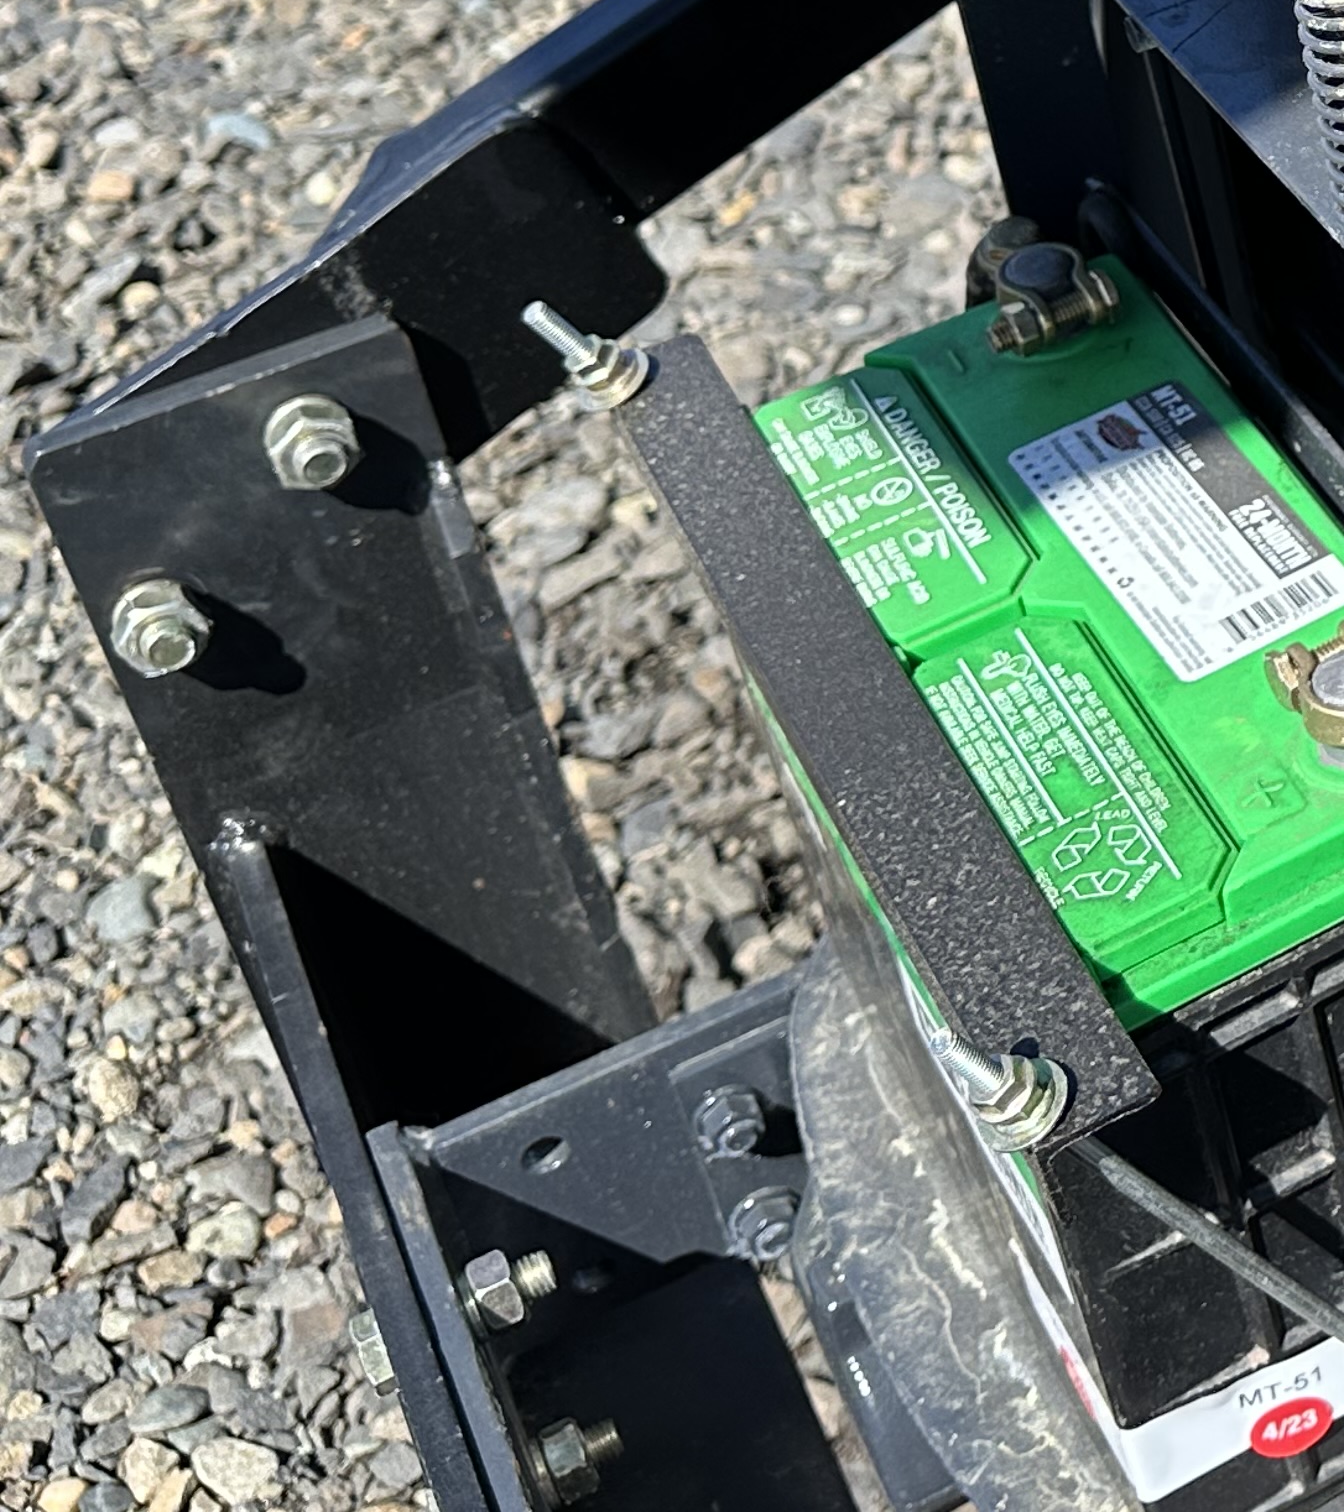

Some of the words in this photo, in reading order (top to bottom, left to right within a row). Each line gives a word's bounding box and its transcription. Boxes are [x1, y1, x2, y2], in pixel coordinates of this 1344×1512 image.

[1148, 384, 1197, 424] MT-51
[882, 407, 943, 475] DANGER
[932, 481, 992, 547] POISON
[1154, 449, 1193, 491] PROPOSITION
[1196, 499, 1228, 531] WARNING
[852, 493, 873, 510] NO
[1236, 497, 1313, 569] 24-MONTH
[877, 537, 919, 581] SULFURIC
[903, 579, 932, 604] ACID
[1070, 672, 1092, 692] KEEP
[1083, 691, 1103, 708] OUT
[988, 688, 1024, 727] MEDICAL
[1013, 727, 1041, 753] HELP
[1029, 751, 1057, 777] FAST
[1005, 681, 1031, 705] WITH
[1041, 737, 1066, 759] GET
[1020, 672, 1052, 703] FLUSH
[1039, 701, 1067, 727] EYES
[1054, 726, 1106, 786] IMMEDIATELY
[1047, 663, 1065, 676] DO
[1056, 676, 1076, 693] NOT
[1077, 706, 1100, 728] KEEP
[1091, 727, 1113, 747] VENT
[1104, 746, 1126, 767] CAPS
[1118, 767, 1142, 790] TIGHT
[1133, 789, 1153, 807] AND
[1094, 707, 1111, 720] OF
[1102, 720, 1122, 737] THE
[1113, 735, 1138, 761] REACH
[1130, 760, 1146, 773] OF
[978, 721, 999, 740] SAFE
[1023, 793, 1052, 822] FOLLOW
[1094, 809, 1130, 819] LEAD
[1030, 866, 1067, 909] RECYCLE
[1237, 1365, 1324, 1409] MT-51
[1260, 1408, 1320, 1441] 4/23
